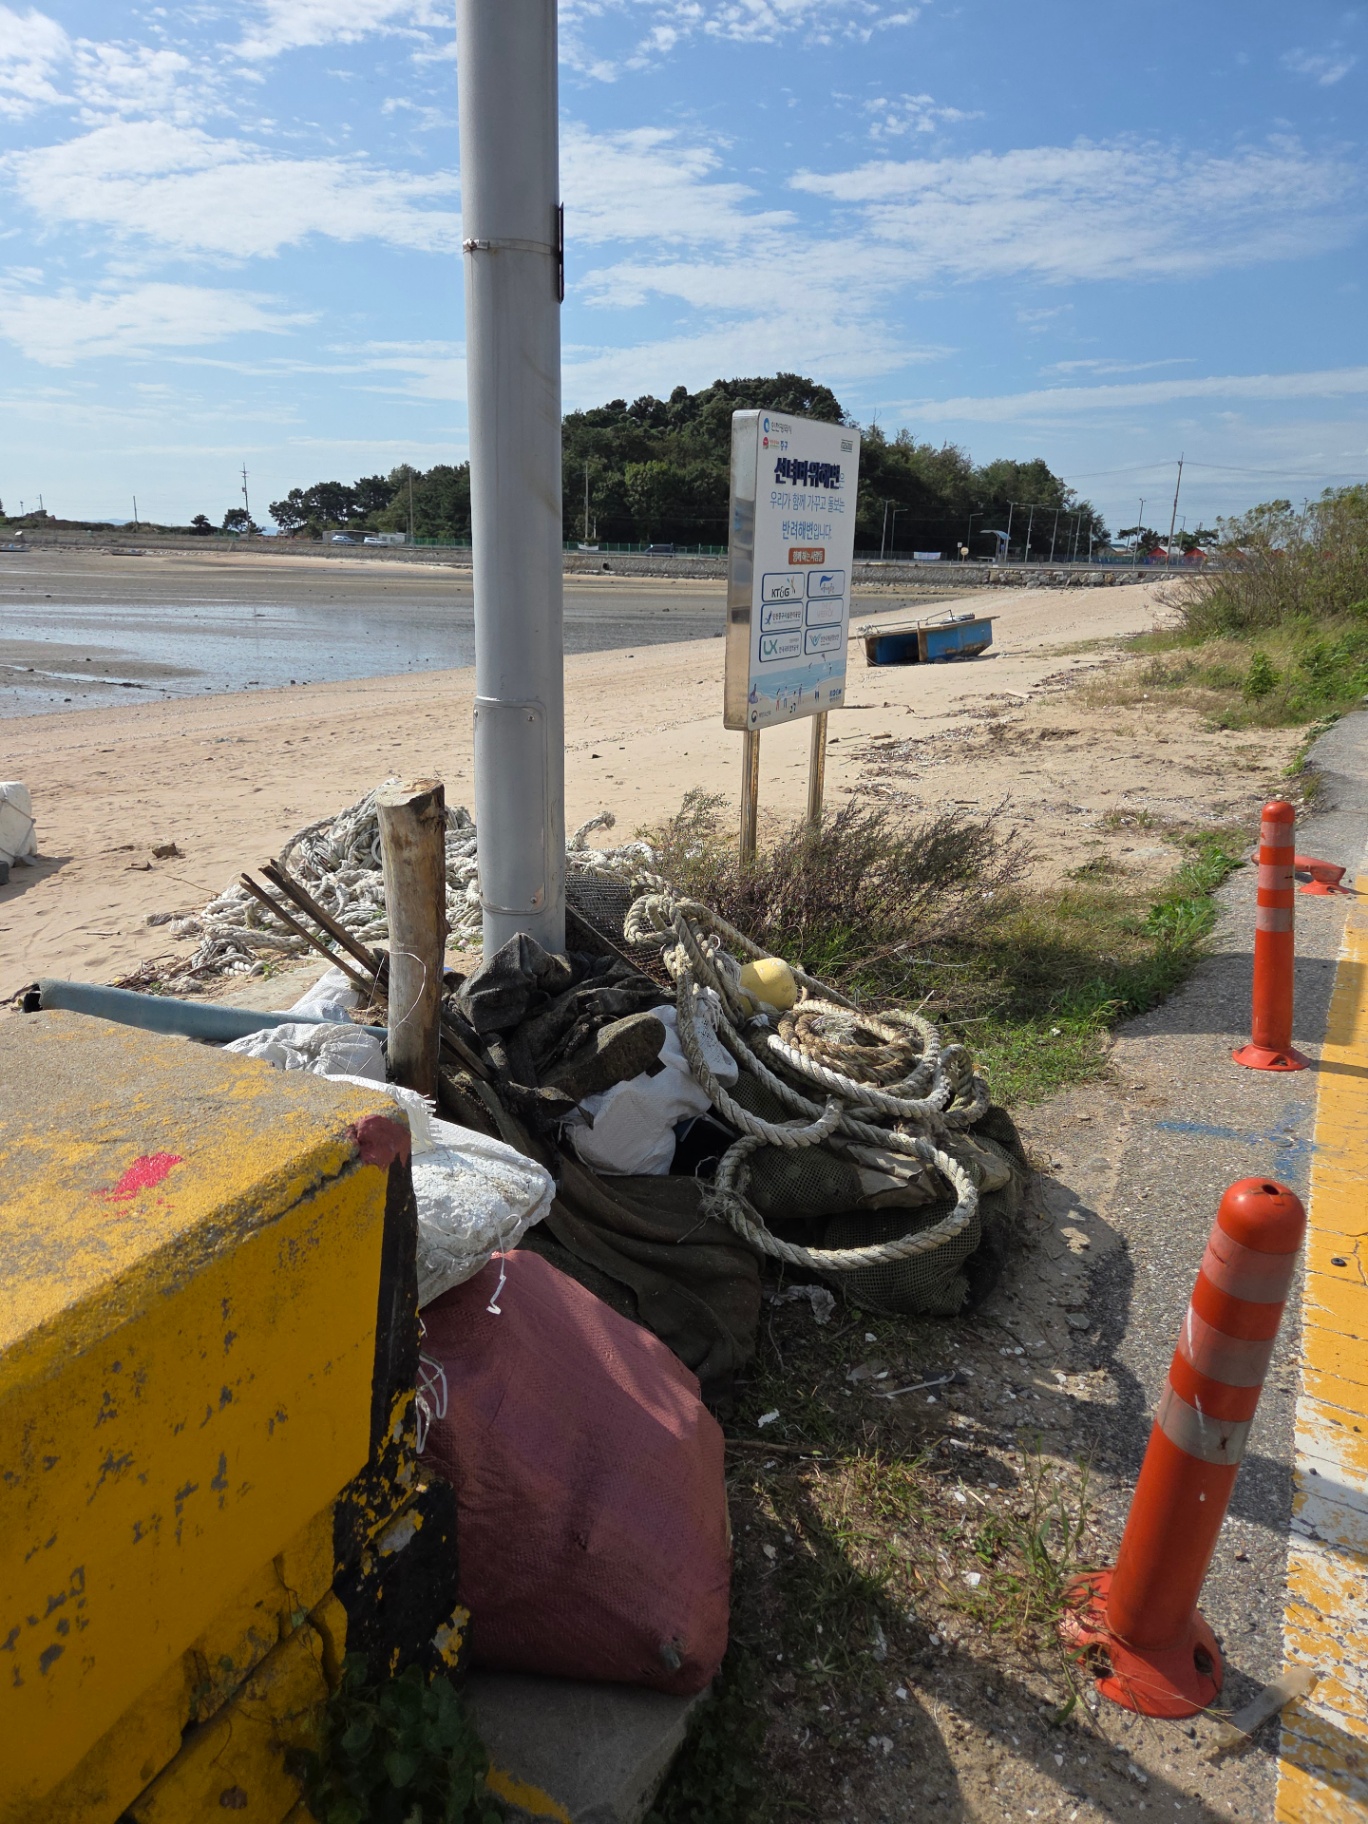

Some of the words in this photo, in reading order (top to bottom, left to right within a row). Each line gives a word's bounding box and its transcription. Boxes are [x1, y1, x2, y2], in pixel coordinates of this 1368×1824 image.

[770, 491, 791, 510] 우리가
[792, 492, 806, 511] 함께
[807, 494, 826, 512] 가꾸고
[828, 495, 845, 513] 돌보는
[771, 585, 790, 598] KT&G
[763, 639, 778, 655] LX
